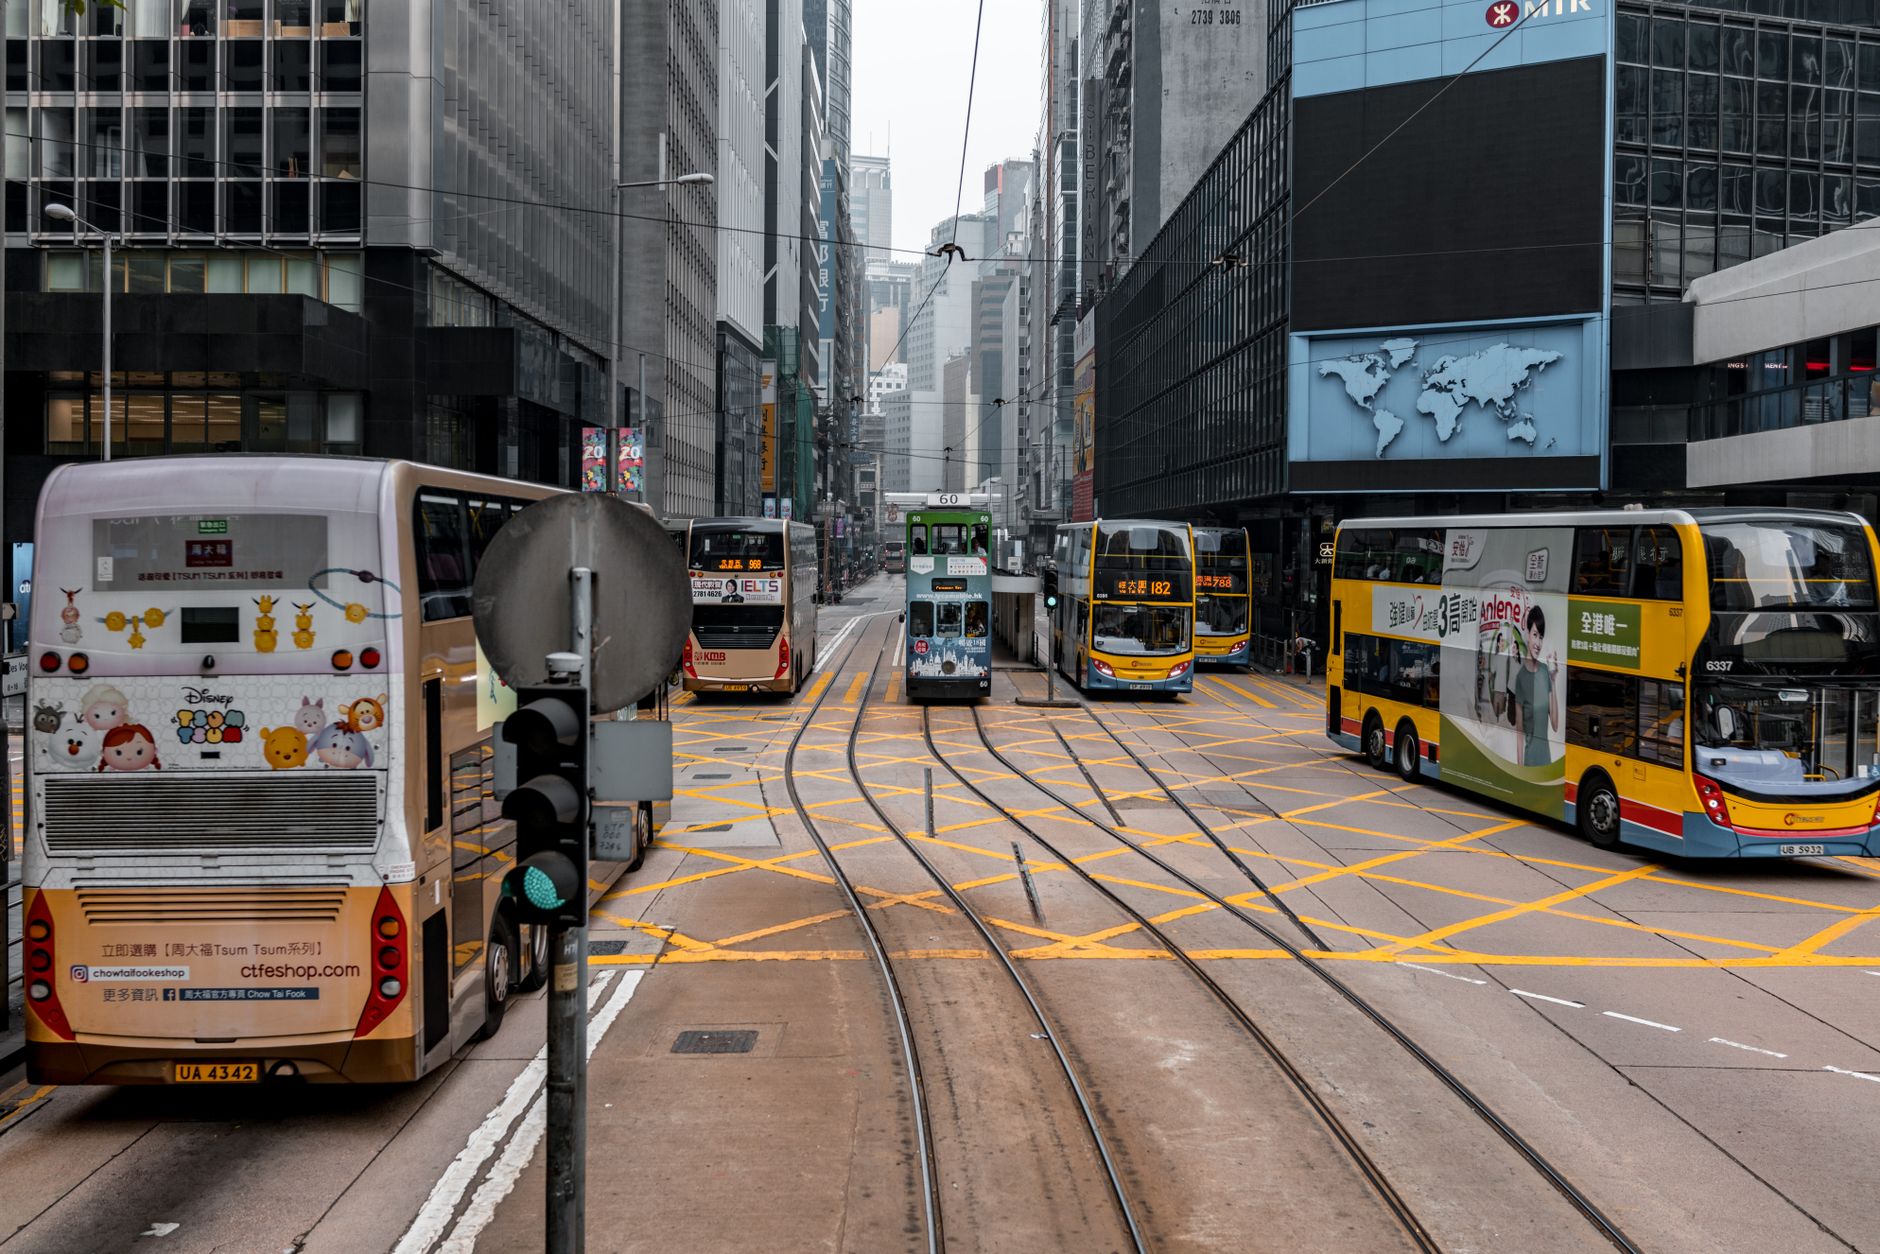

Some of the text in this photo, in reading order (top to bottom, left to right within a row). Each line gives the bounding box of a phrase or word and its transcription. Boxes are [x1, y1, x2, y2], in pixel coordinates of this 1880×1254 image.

[1192, 10, 1213, 24] 2739
[1085, 104, 1096, 260] SIBERIAN
[583, 446, 603, 460] 20
[619, 446, 640, 460] 20
[939, 494, 958, 505] 60
[749, 560, 762, 569] 968
[741, 580, 778, 593] IELTS
[1151, 581, 1171, 595] 182
[1213, 579, 1232, 588] 788
[1480, 594, 1521, 623] Anlene
[1581, 612, 1628, 636] 全港唯一
[704, 652, 726, 661] KMB
[1706, 661, 1732, 671] 6337
[181, 686, 234, 709] Disney
[1798, 845, 1822, 854] 5932
[92, 968, 186, 979] chowtaifookeshop
[240, 963, 360, 981] ctfeshop.com
[103, 988, 158, 1002] 更多資訊
[247, 989, 271, 998] Chow
[273, 989, 284, 998] Tai
[285, 989, 306, 998] Fook
[179, 1065, 253, 1080] UA 4342
